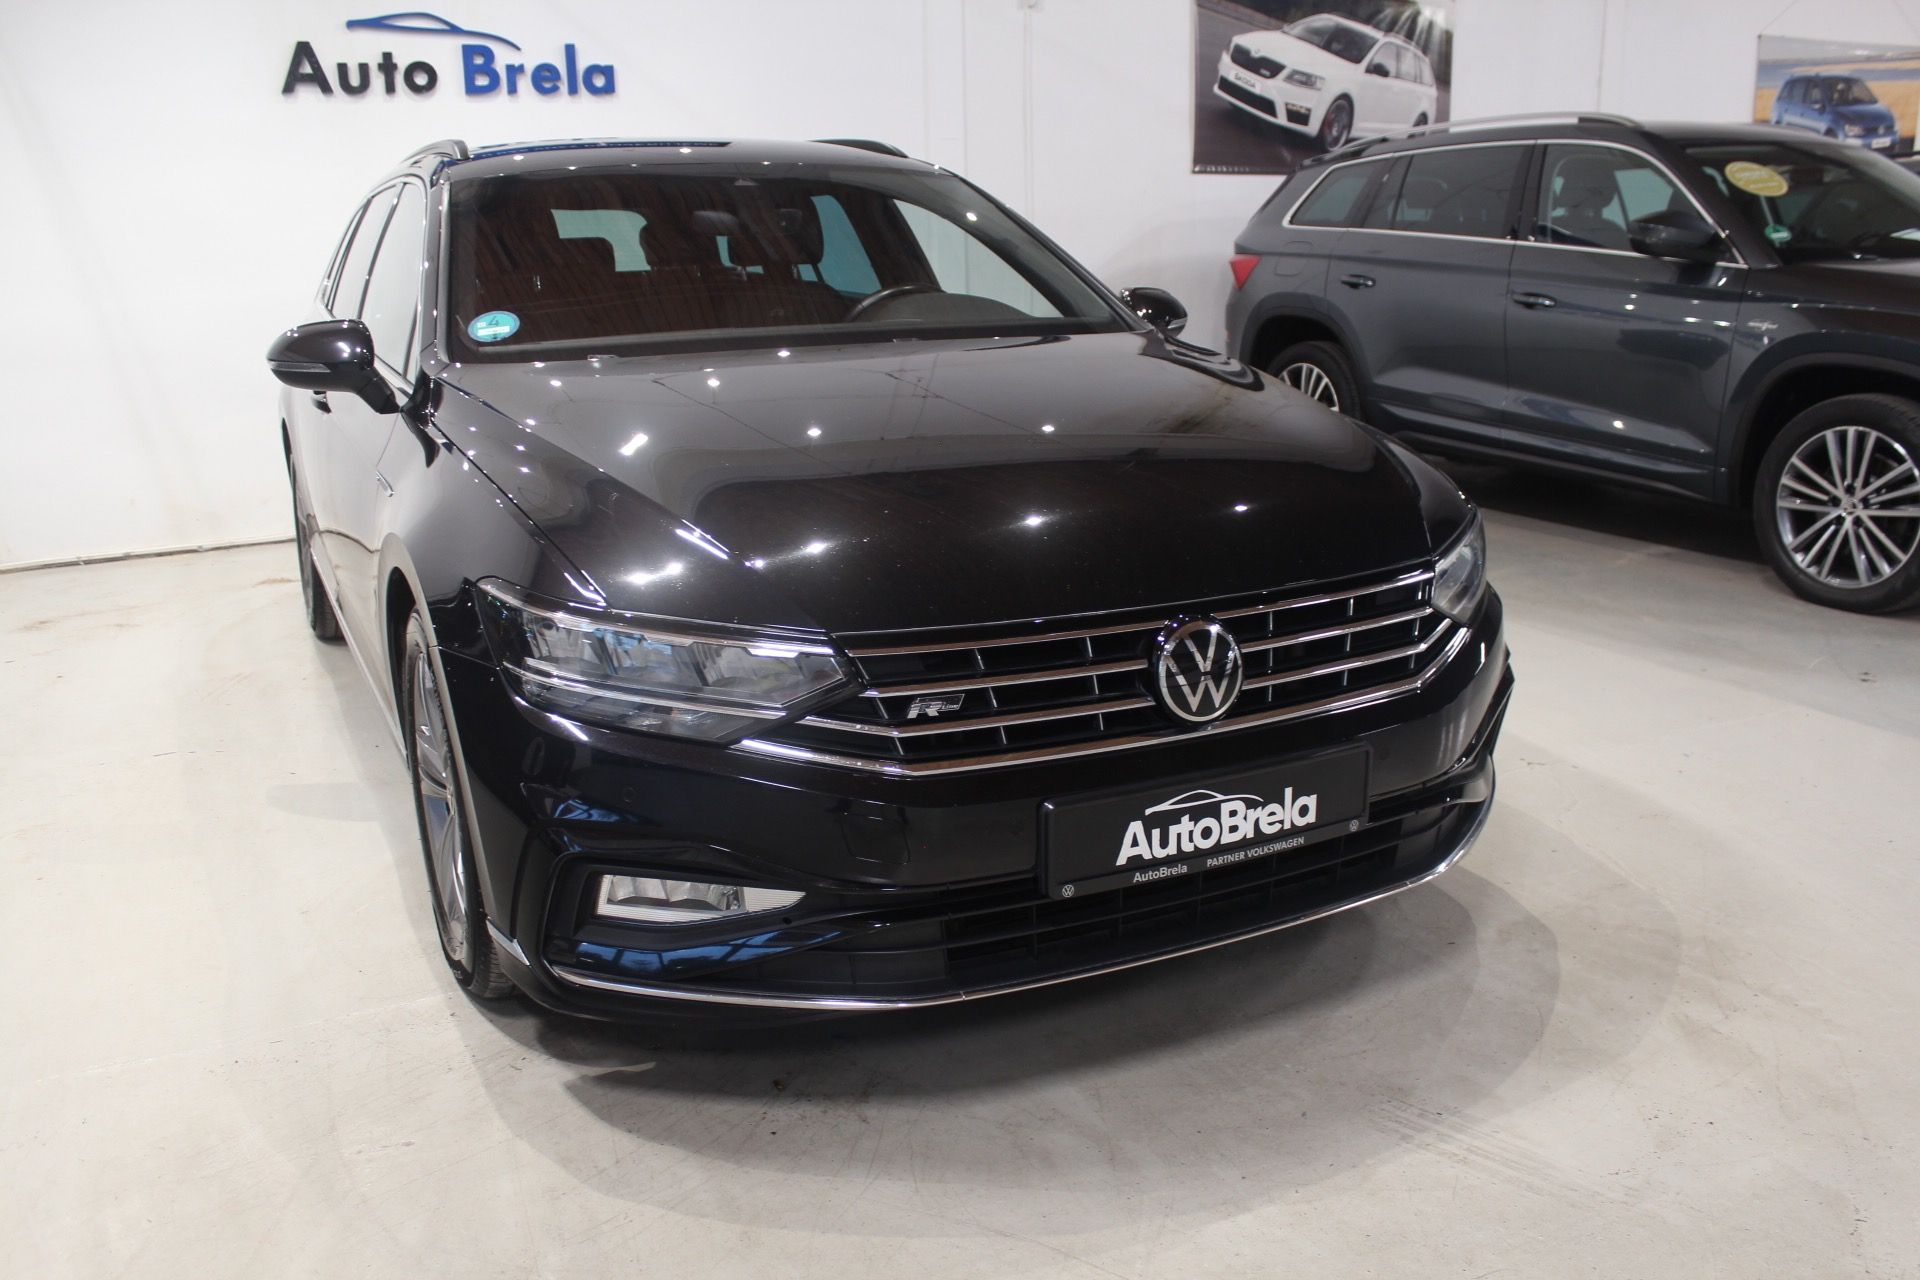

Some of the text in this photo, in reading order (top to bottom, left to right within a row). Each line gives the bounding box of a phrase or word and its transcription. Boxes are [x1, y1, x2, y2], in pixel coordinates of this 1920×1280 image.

[282, 41, 616, 95] Auto Brela
[1115, 787, 1317, 866] AutoBrela
[1133, 836, 1305, 883] AutoBrela PARTNER VOLKSWAGEN
